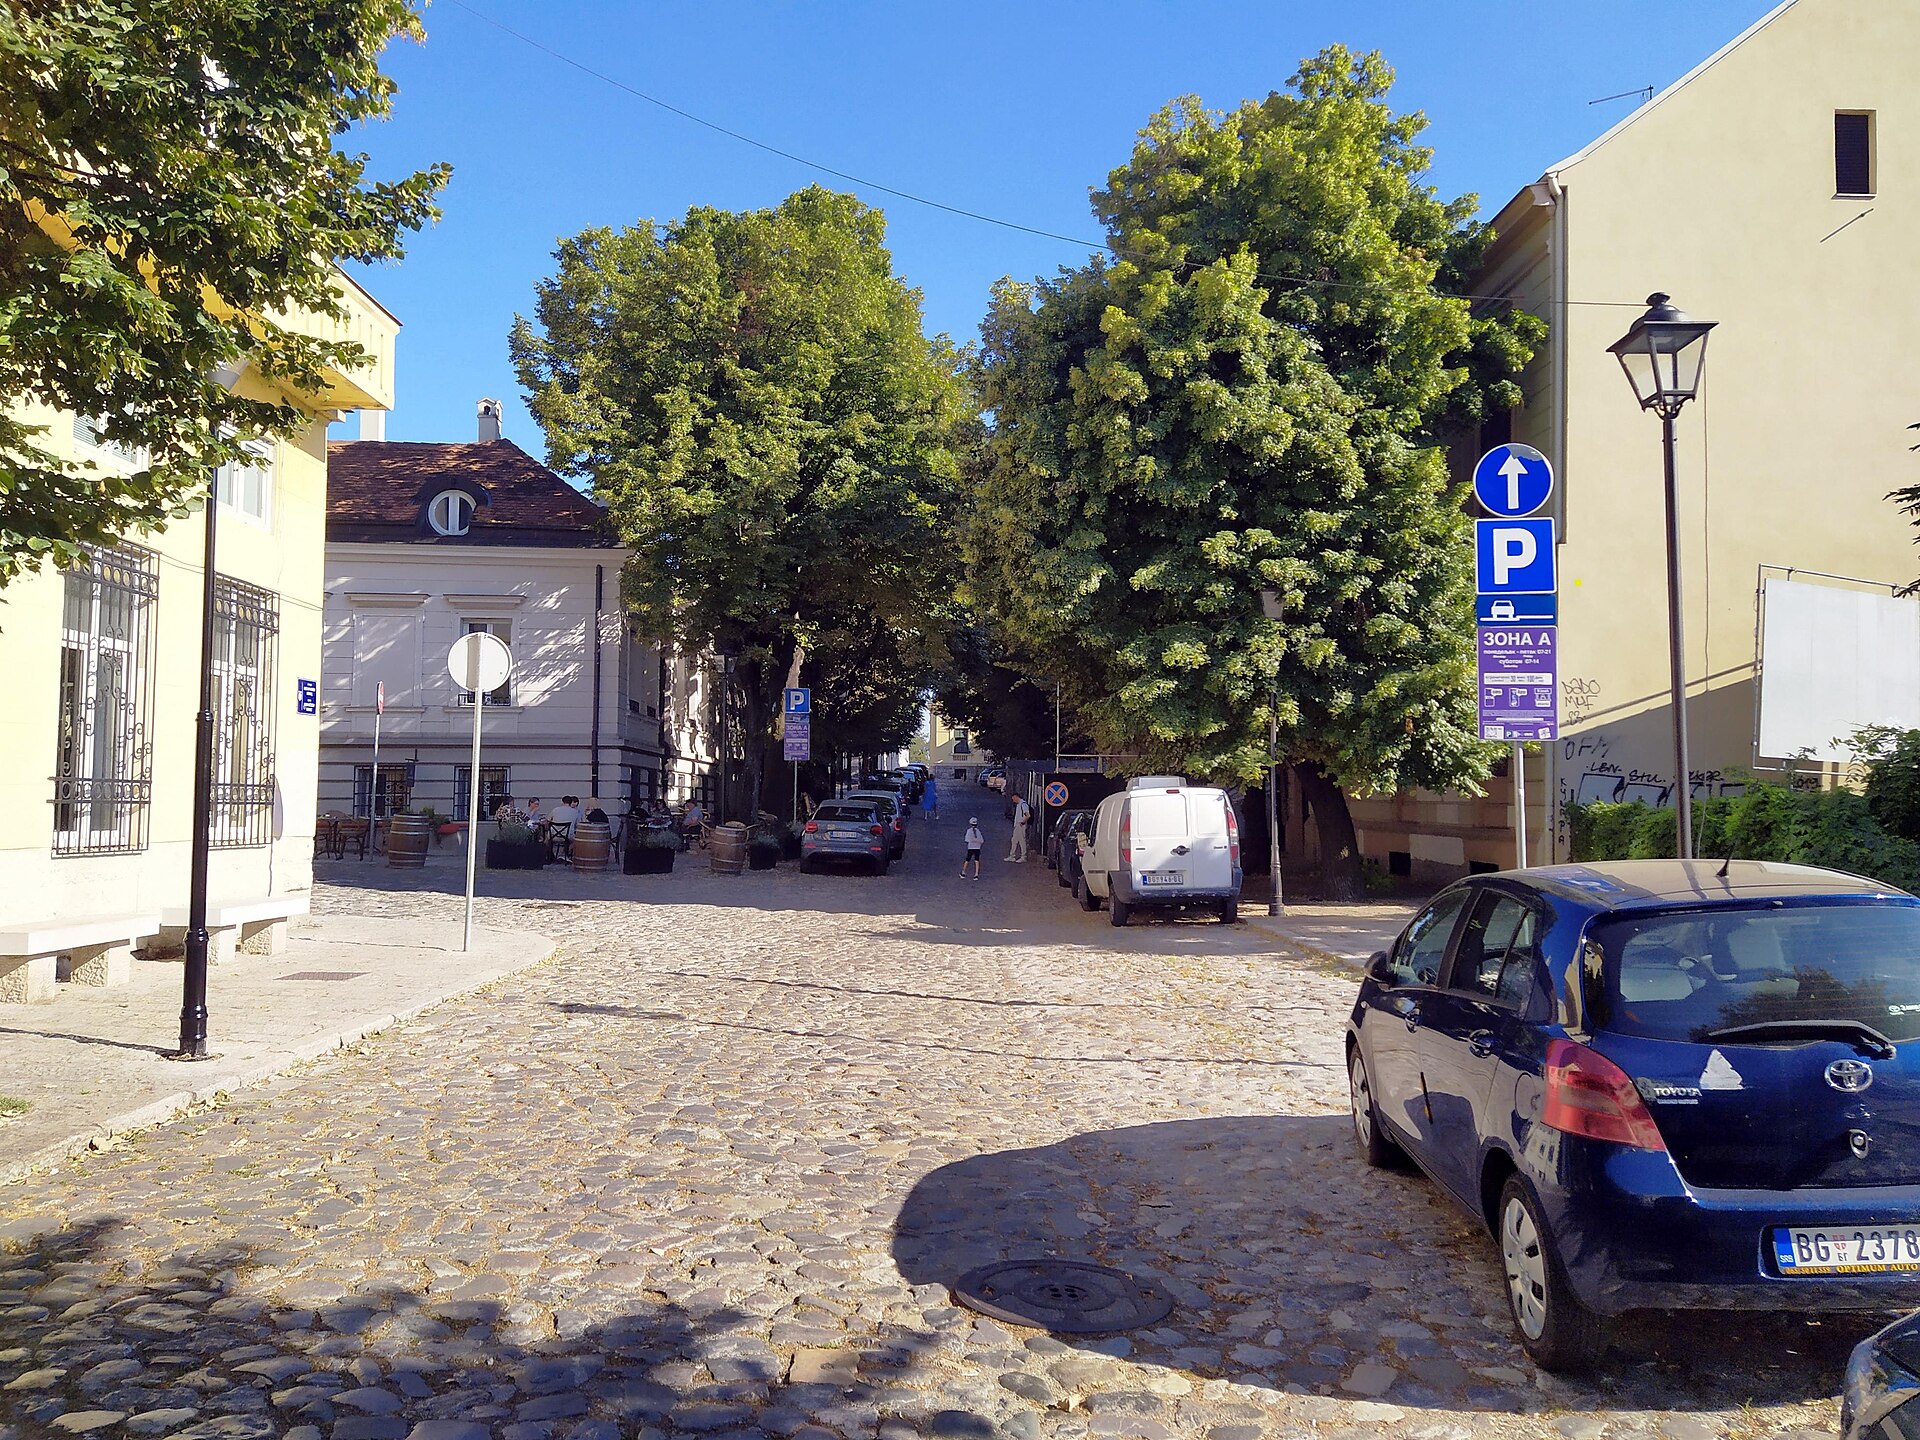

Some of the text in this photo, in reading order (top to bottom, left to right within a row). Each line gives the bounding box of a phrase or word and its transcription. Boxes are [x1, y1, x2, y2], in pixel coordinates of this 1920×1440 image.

[1492, 528, 1537, 585] P
[1483, 632, 1533, 646] ЗОНА
[790, 691, 804, 710] P
[1653, 1087, 1702, 1096] TOYOTA
[1795, 1230, 1920, 1262] BG 2378
[1836, 1264, 1886, 1273] OPTIMUM
[1890, 1263, 1919, 1271] AUTO
